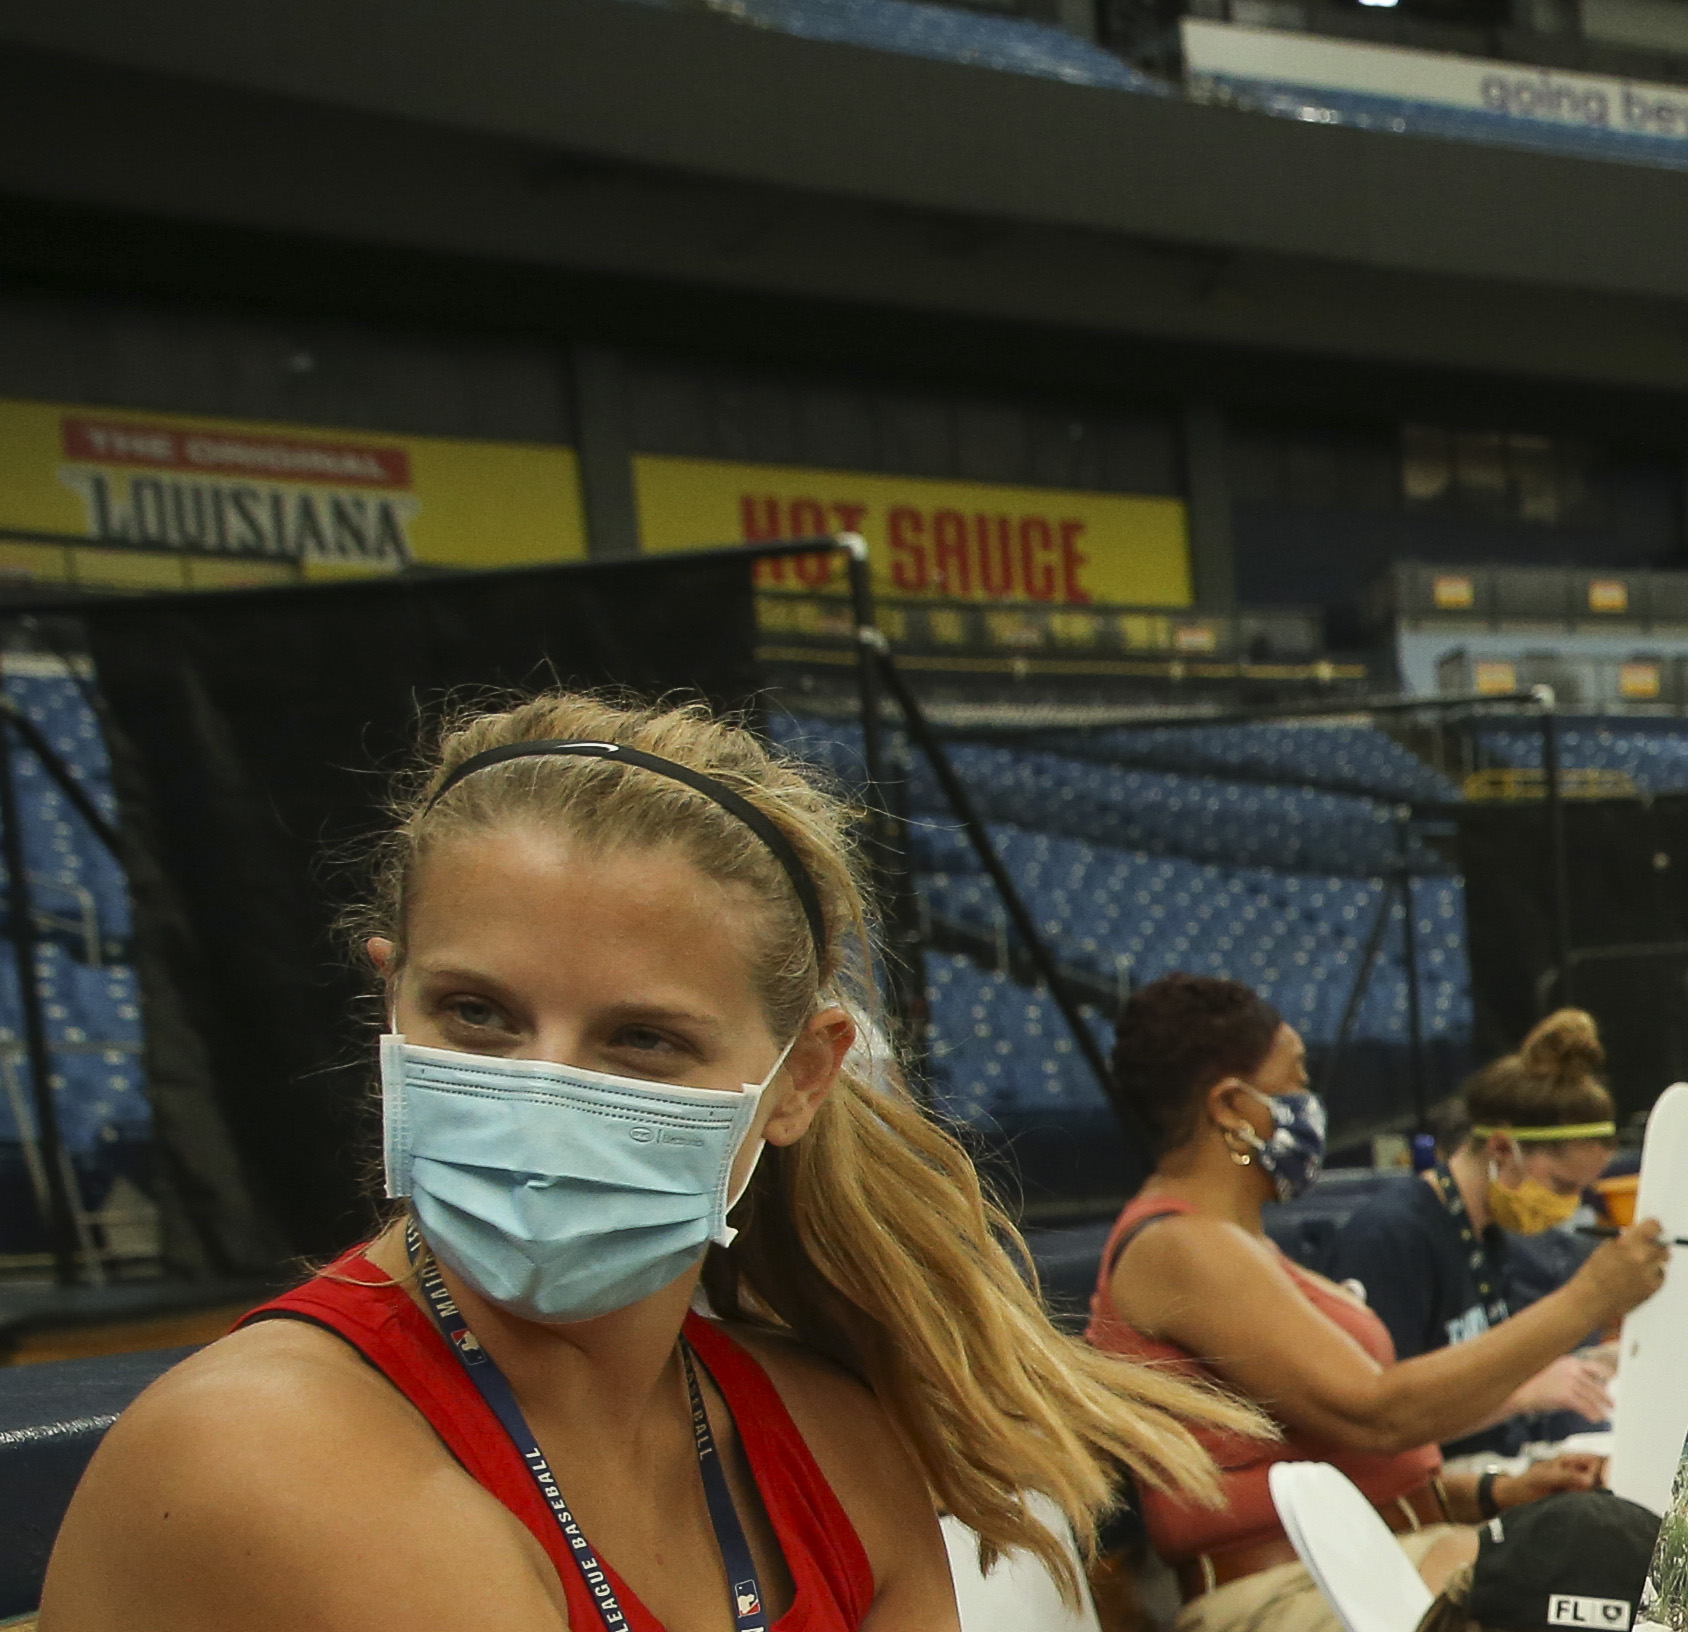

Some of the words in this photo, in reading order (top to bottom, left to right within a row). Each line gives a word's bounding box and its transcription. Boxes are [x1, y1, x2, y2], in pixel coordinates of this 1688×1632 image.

[1481, 70, 1608, 126] going
[87, 425, 173, 460] THE
[184, 434, 389, 481] ORIGINAL
[88, 472, 415, 565] LOUISIANA
[886, 505, 1090, 606] SAUCE
[525, 1446, 588, 1549] BASEBALL
[1555, 1600, 1586, 1622] FL
